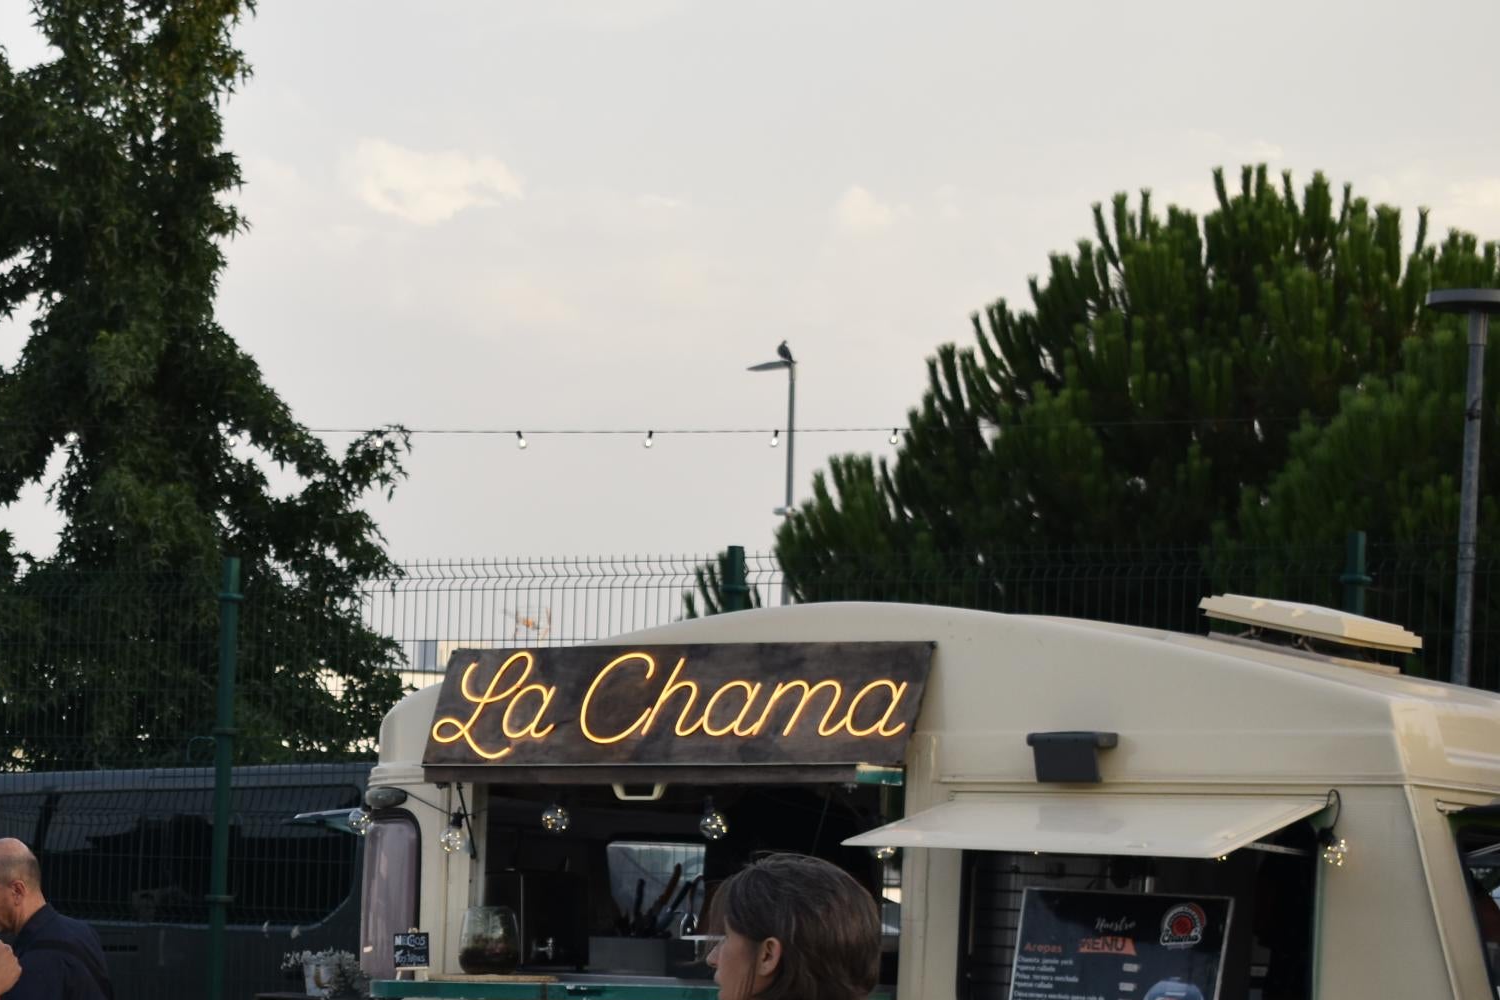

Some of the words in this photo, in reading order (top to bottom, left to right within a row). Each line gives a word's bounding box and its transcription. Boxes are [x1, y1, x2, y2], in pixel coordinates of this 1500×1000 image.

[432, 651, 556, 760] La
[580, 651, 908, 745] Chama
[1024, 943, 1062, 954] Arepas
